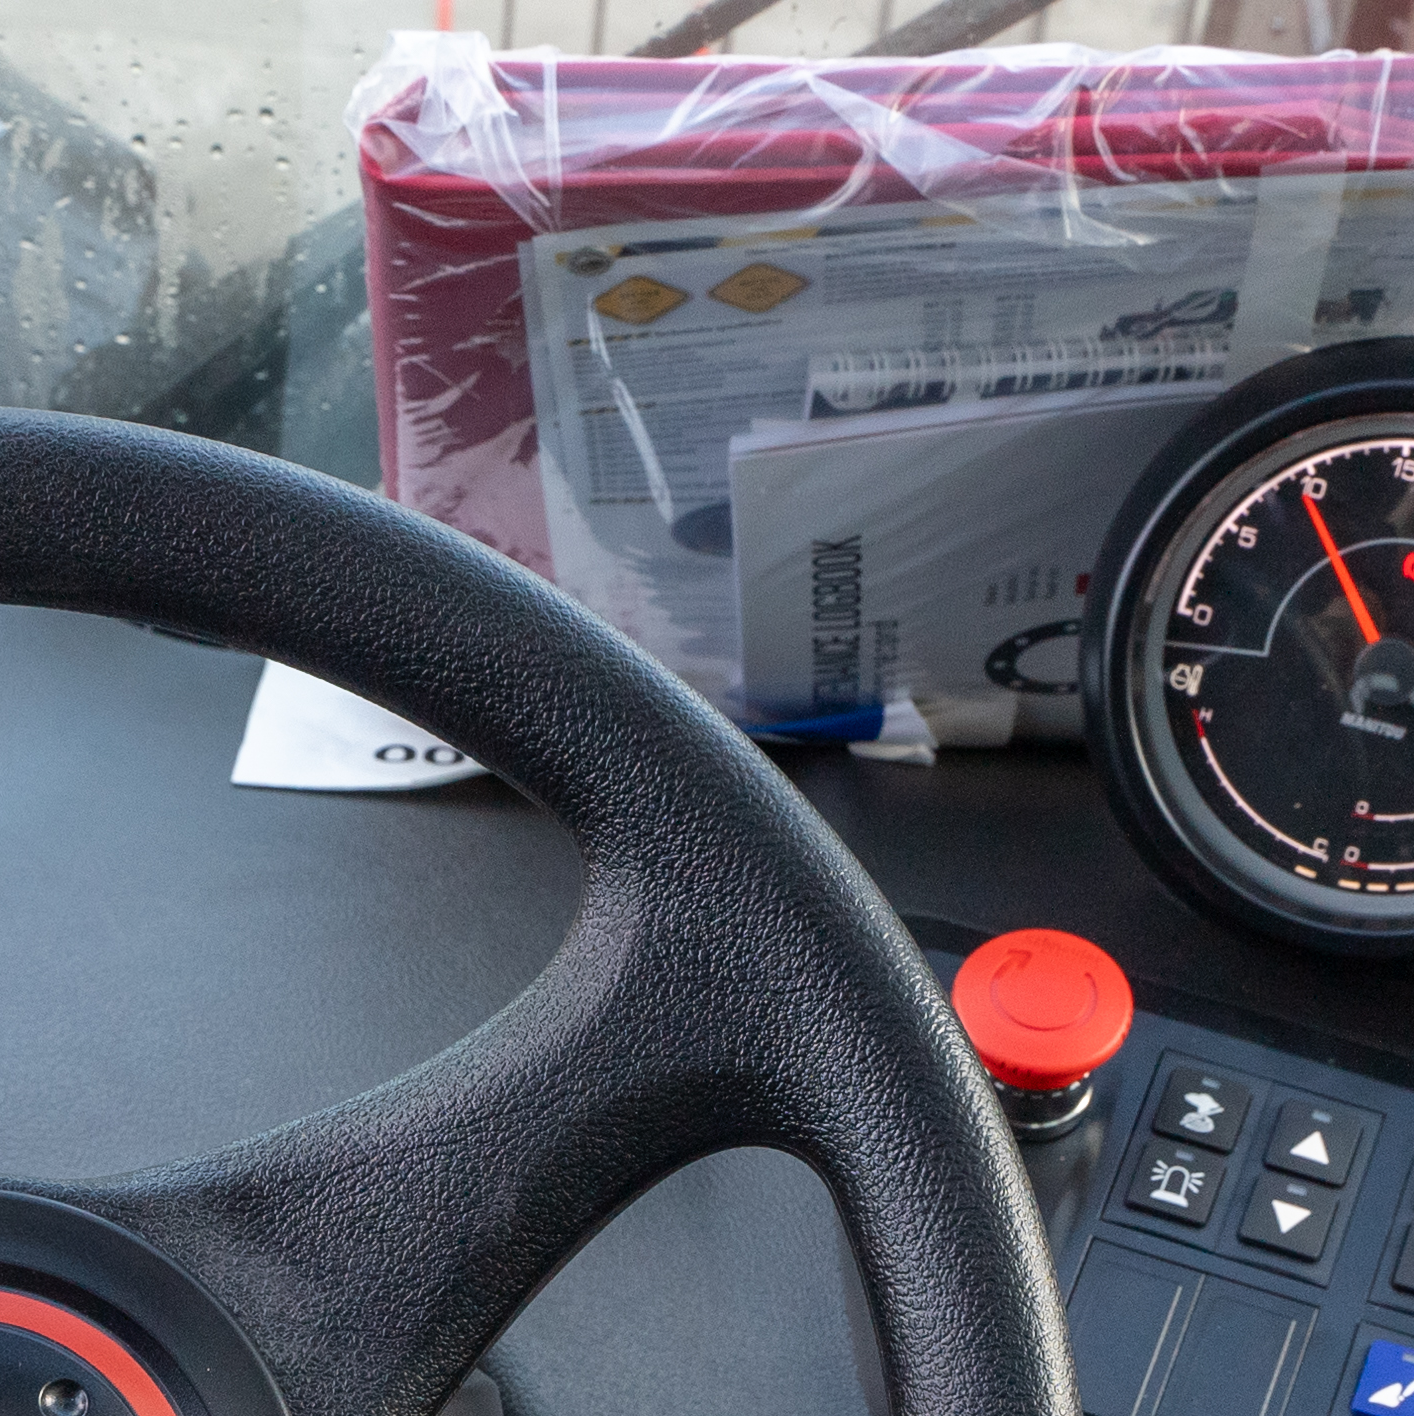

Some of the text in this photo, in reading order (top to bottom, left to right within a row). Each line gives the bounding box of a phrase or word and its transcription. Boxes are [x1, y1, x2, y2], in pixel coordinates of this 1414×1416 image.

[1299, 475, 1328, 500] 10
[1237, 525, 1259, 549] 5
[1192, 603, 1214, 627] 0
[1198, 706, 1214, 723] H
[1354, 800, 1370, 815] 0
[1343, 845, 1361, 863] 0
